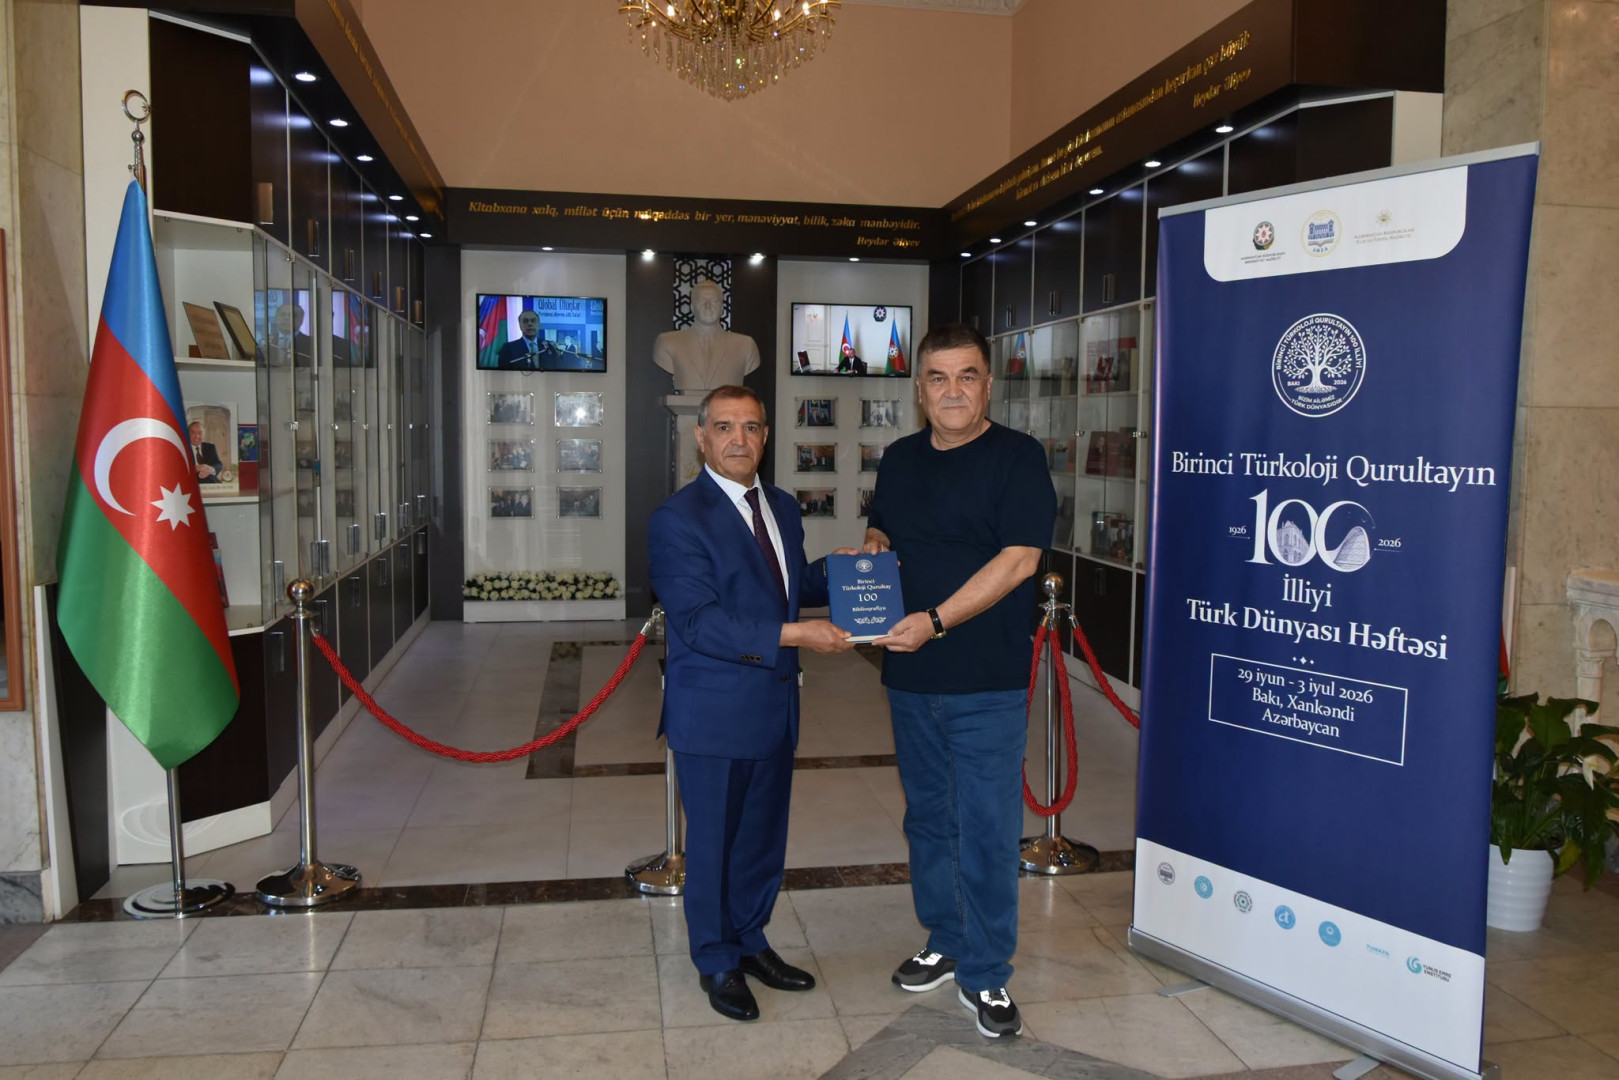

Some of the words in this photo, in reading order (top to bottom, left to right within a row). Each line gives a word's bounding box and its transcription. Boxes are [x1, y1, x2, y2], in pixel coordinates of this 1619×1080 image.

[468, 202, 528, 214] Kitabxana
[564, 205, 598, 217] millət
[602, 206, 630, 220] üçün
[634, 208, 690, 222] müqəddəs
[694, 210, 712, 222] bir
[714, 213, 735, 224] yer,
[804, 215, 829, 227] bilik,
[831, 216, 856, 227] zəka
[860, 218, 920, 231] mənbəyidir.
[857, 236, 889, 248] Heydər
[892, 238, 920, 249] Əliyev
[1284, 318, 1314, 345] TÜRKOLOJİ
[1172, 451, 1234, 476] Birinci
[1240, 453, 1338, 486] Türkoloji
[1346, 454, 1496, 492] Qurultayın
[1228, 526, 1247, 536] 1926
[1244, 488, 1376, 573] 100
[1378, 536, 1402, 549] 2026
[859, 593, 877, 601] 100
[1282, 574, 1332, 612] İlliyi
[1186, 598, 1238, 627] Türk
[1242, 606, 1341, 644] Dünyası
[1348, 622, 1448, 660] Həftəsi
[1238, 668, 1253, 684] 29
[1255, 668, 1285, 690] iyun
[1298, 680, 1306, 695] 3
[1308, 678, 1335, 700] iyul
[1339, 687, 1374, 704] 2026
[1252, 688, 1284, 710] Bakı,
[1287, 694, 1355, 722] Xankəndi
[1262, 708, 1340, 738] Azərbaycan
[1422, 964, 1438, 974] YUNUS
